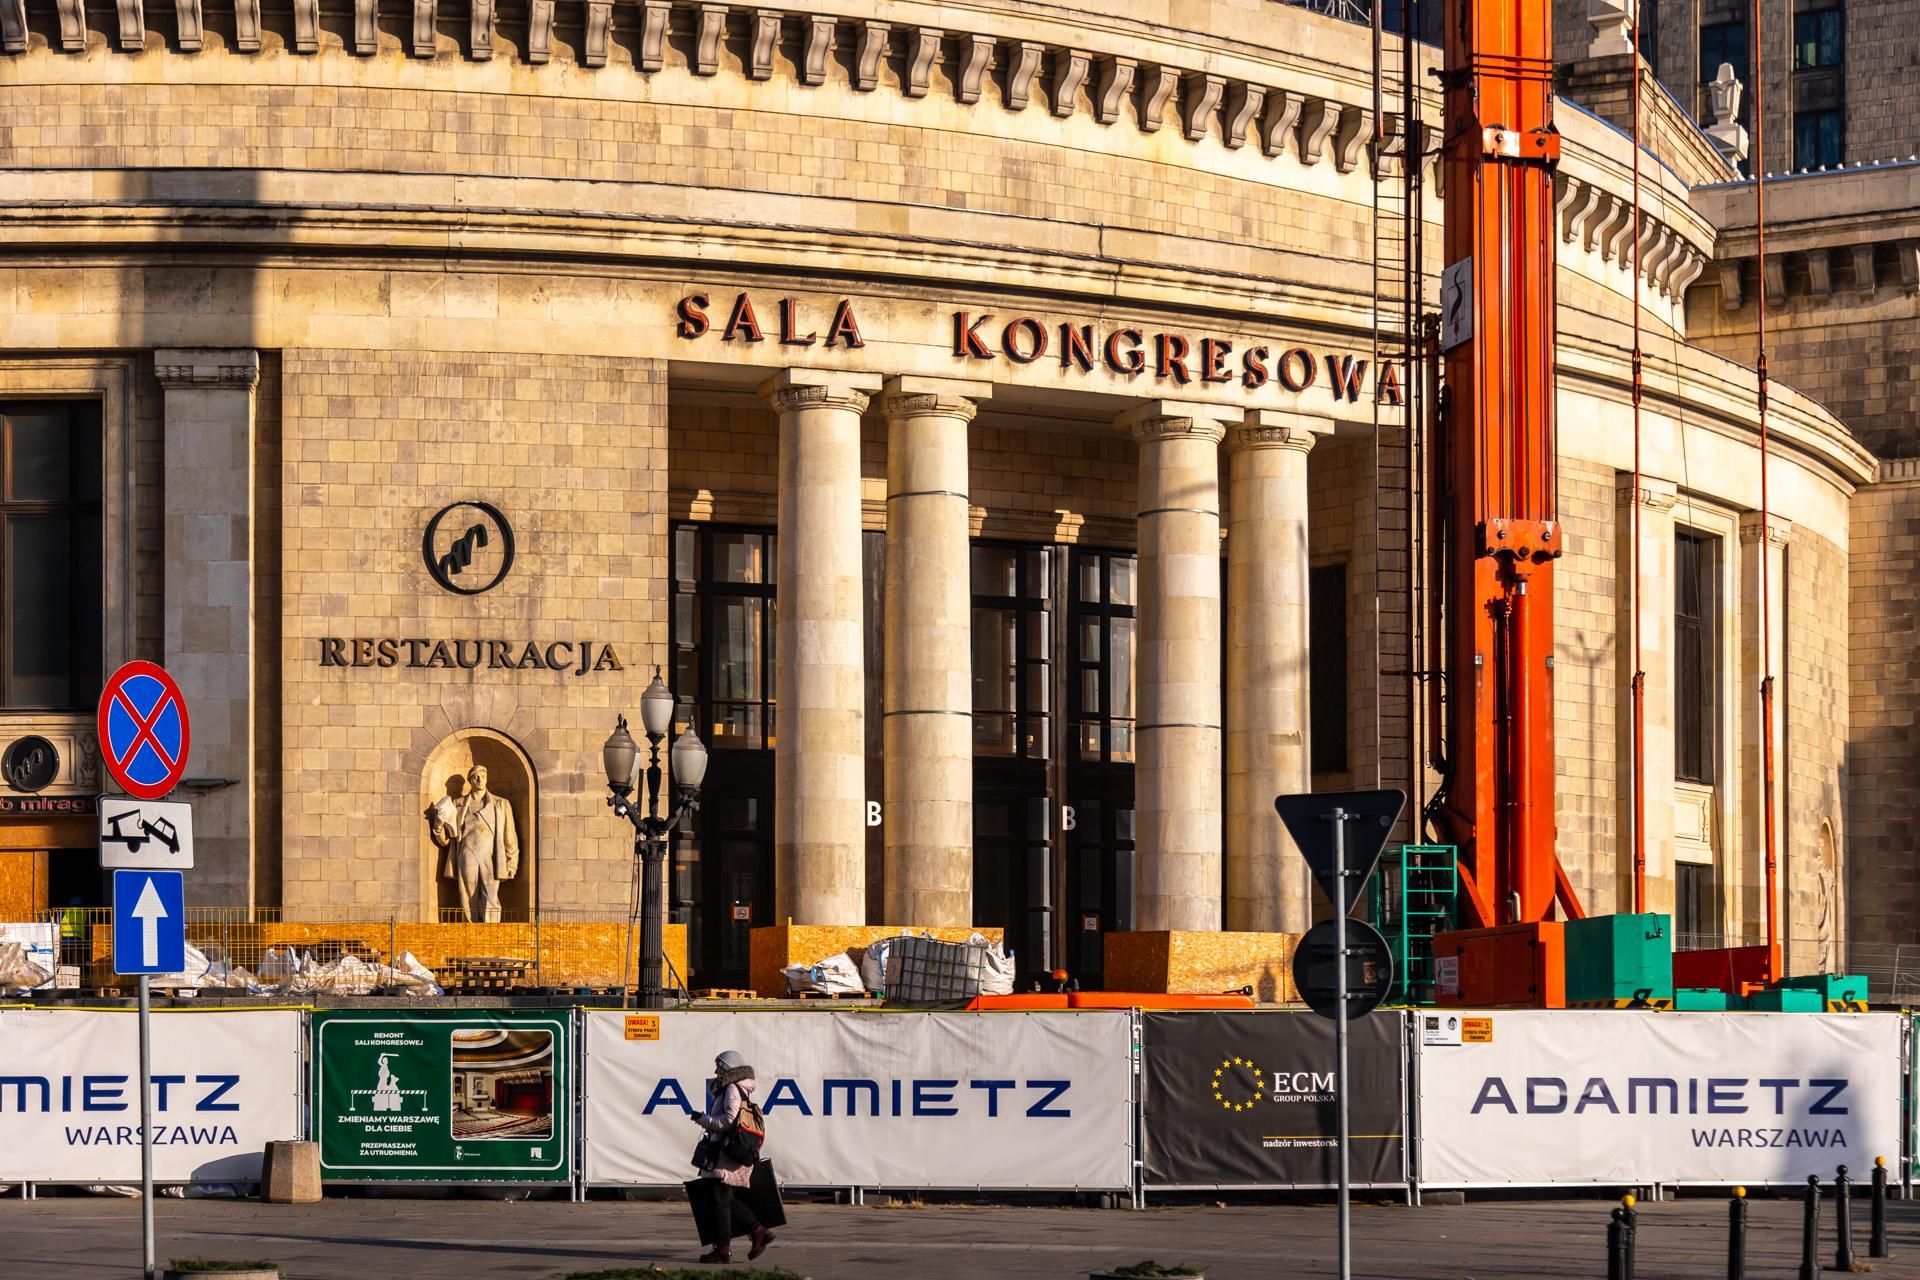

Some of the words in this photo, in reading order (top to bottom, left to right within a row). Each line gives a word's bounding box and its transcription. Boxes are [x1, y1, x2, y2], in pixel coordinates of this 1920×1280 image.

[677, 291, 866, 348] SALA
[952, 311, 1404, 404] KONGRESOWA
[319, 637, 624, 676] RESTAURACJA
[866, 800, 882, 827] B
[1062, 805, 1077, 831] B
[1273, 1072, 1336, 1093] ECM
[641, 1077, 1071, 1118] AAMIETZ
[1273, 1095, 1302, 1103] GROUP
[1303, 1095, 1336, 1103] POLSKA
[1470, 1077, 1849, 1115] ADAMIETZ
[338, 1115, 388, 1123] ZMIENIAMY
[388, 1115, 440, 1125] WARSZAWĘ
[1262, 1139, 1292, 1148] nadzór
[1692, 1128, 1848, 1148] WARSZAWA
